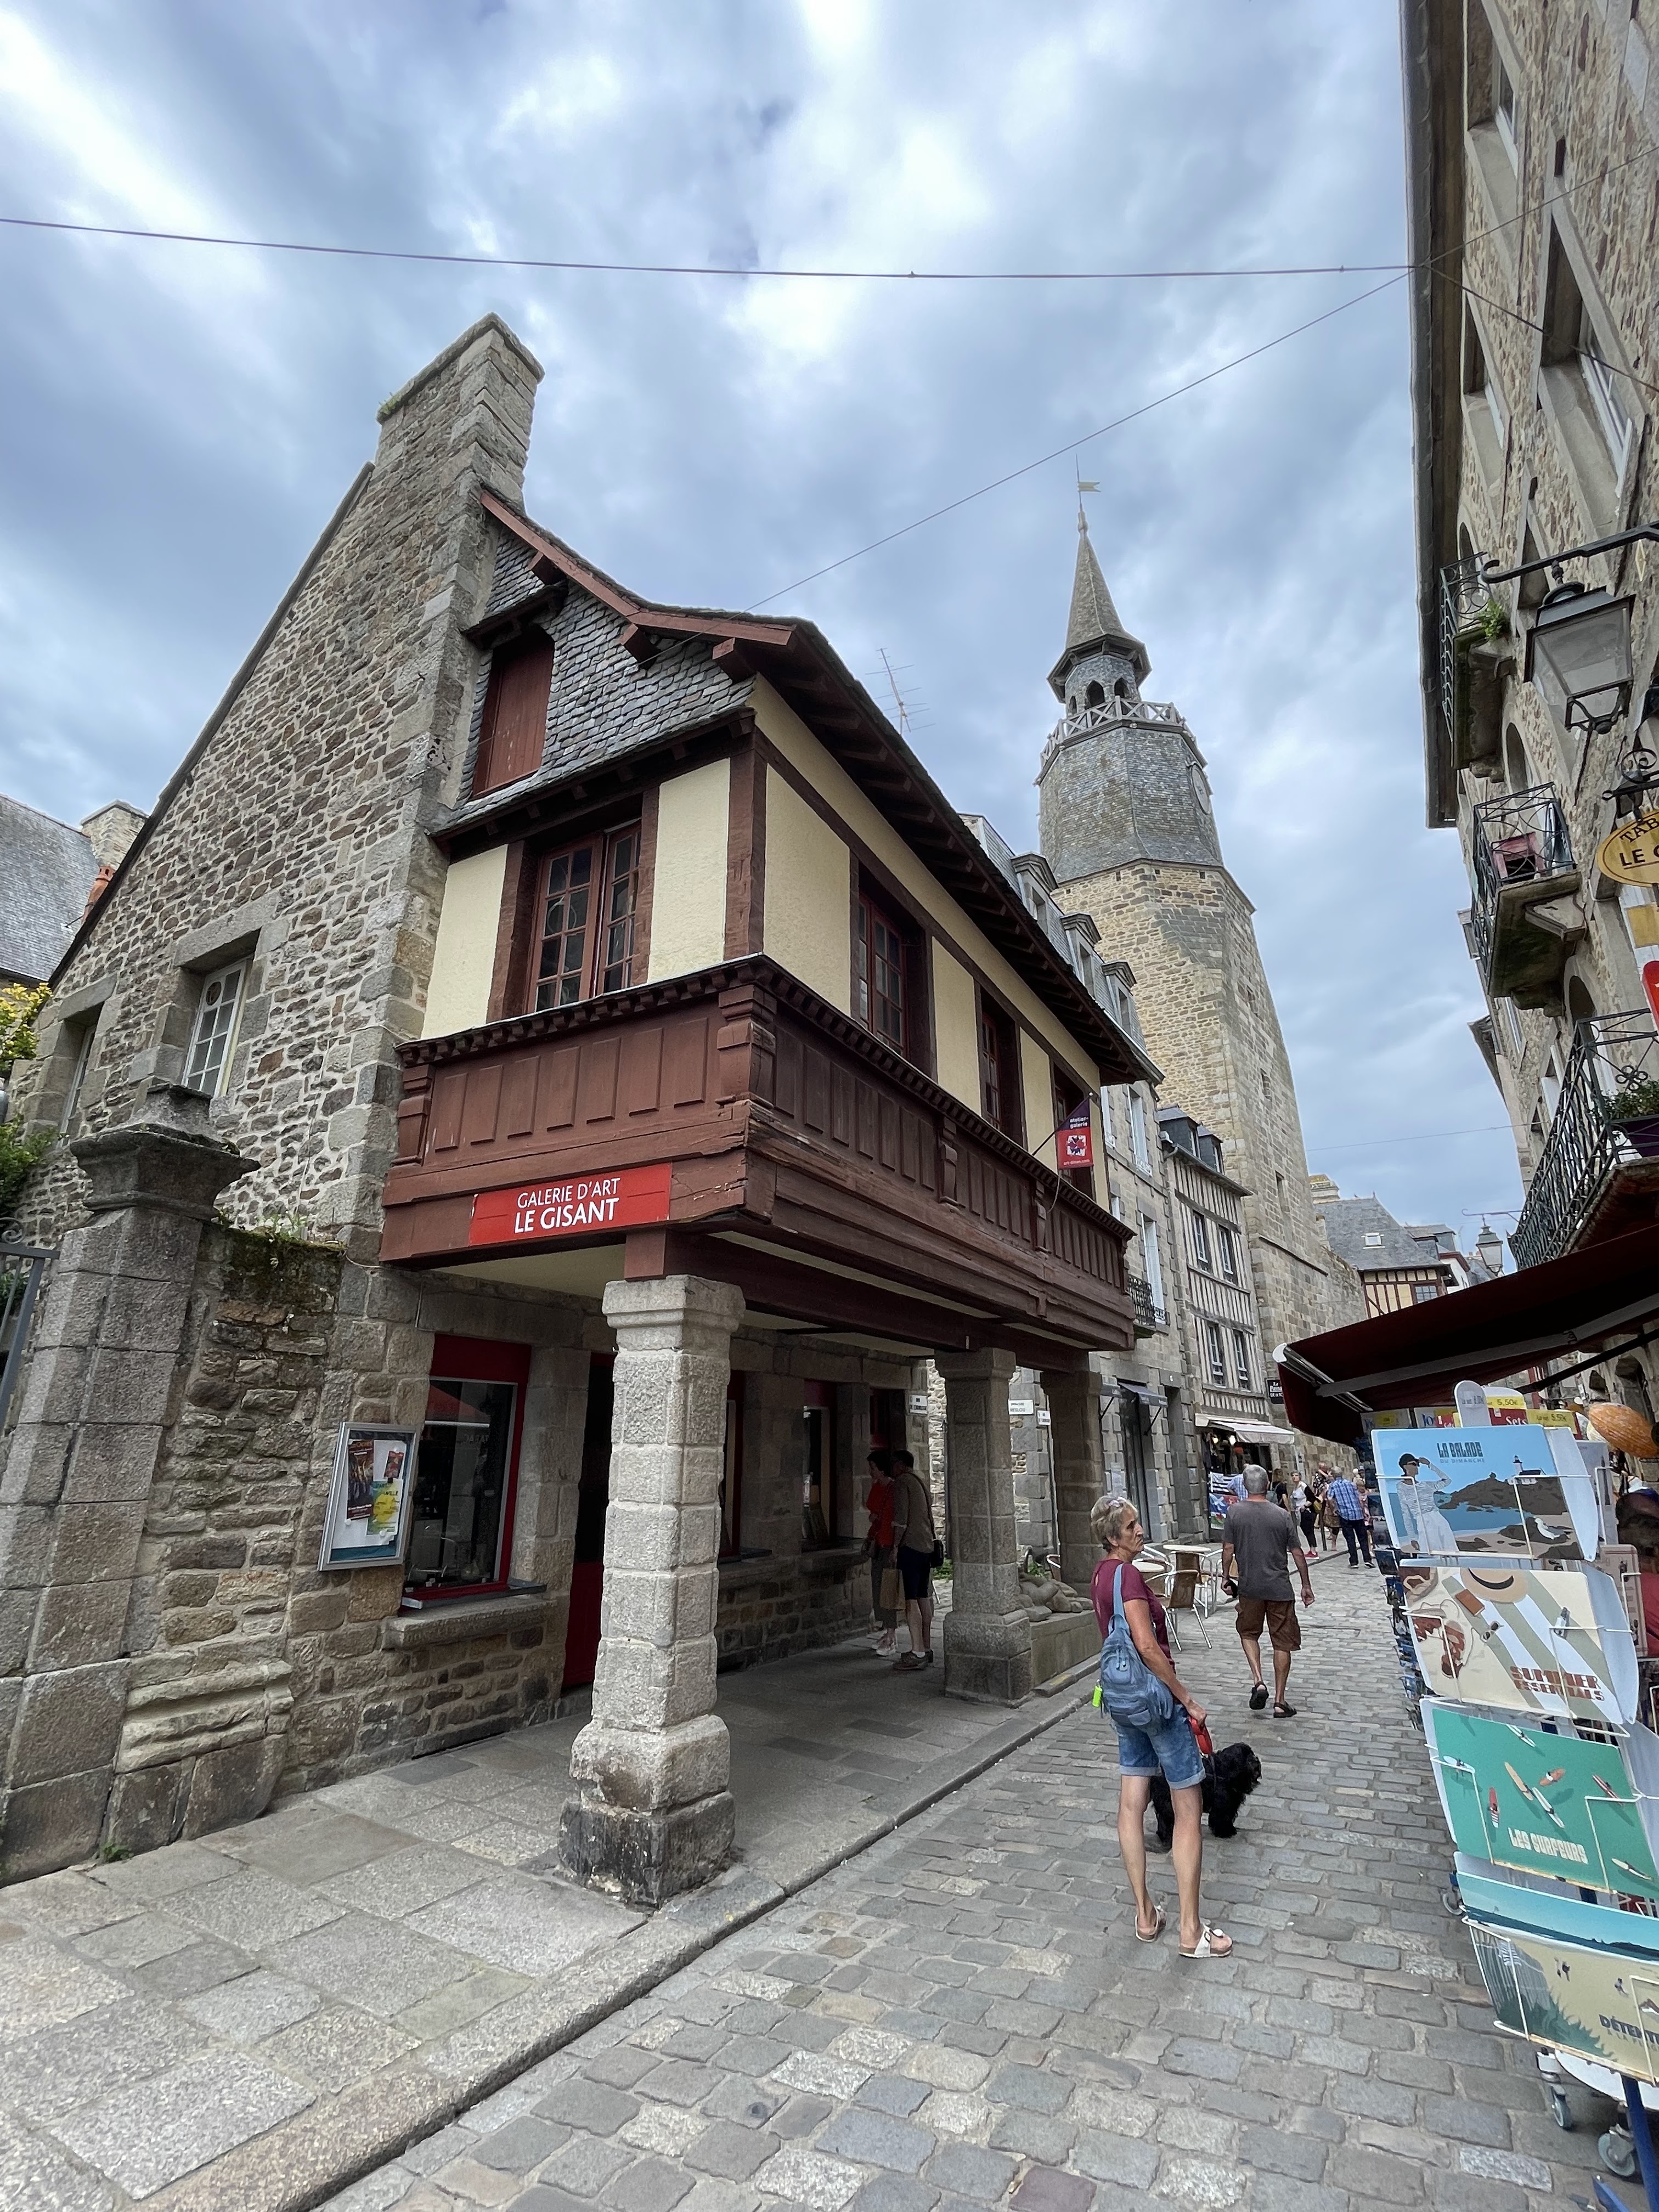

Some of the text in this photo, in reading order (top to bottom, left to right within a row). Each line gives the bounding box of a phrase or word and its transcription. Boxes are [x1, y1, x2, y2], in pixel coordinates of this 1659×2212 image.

[1619, 849, 1645, 866] LE
[517, 1178, 621, 1209] GALERIE D'ART
[515, 1198, 619, 1234] LE GISANT
[1436, 1442, 1483, 1458] LA BALADE
[1510, 1666, 1601, 1689] SUMMER
[1508, 1827, 1588, 1865] LES SURFEURS
